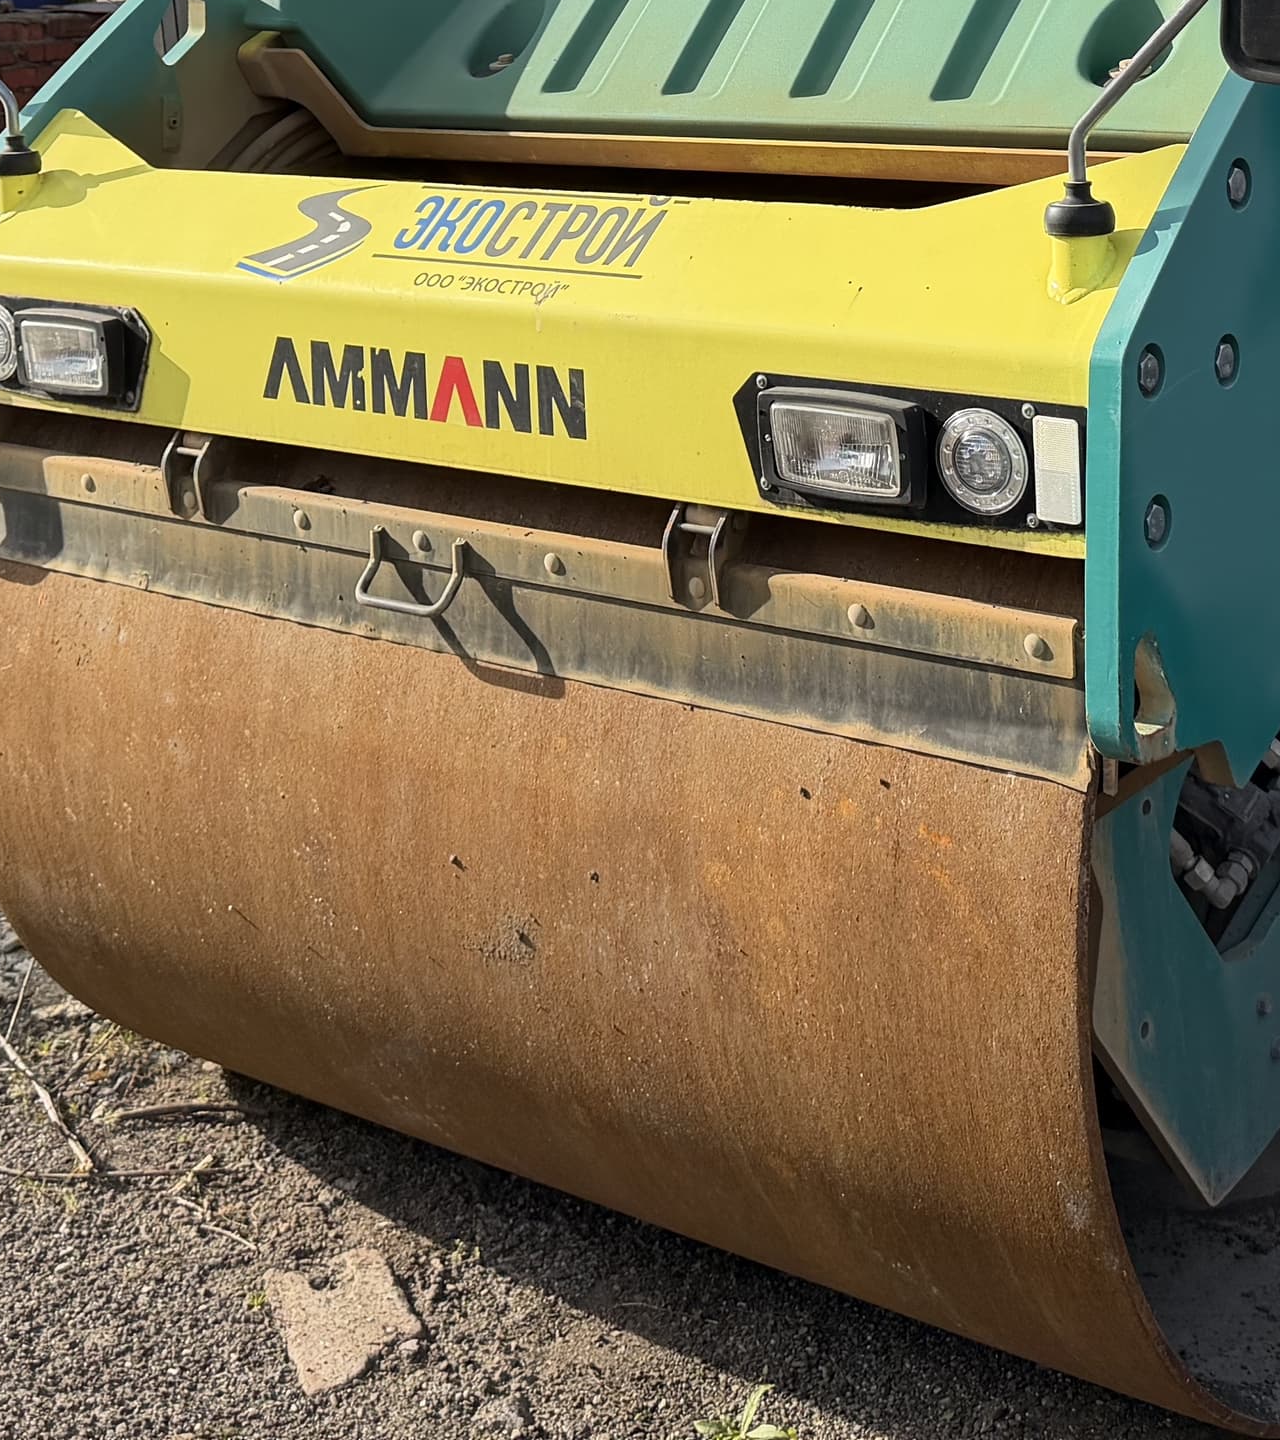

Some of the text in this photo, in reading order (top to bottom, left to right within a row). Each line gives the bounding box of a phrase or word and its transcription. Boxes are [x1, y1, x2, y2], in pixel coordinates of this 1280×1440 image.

[393, 194, 670, 268] ЭКОСТРОЙ
[413, 272, 454, 289] ООО
[262, 335, 588, 441] AMMANN
